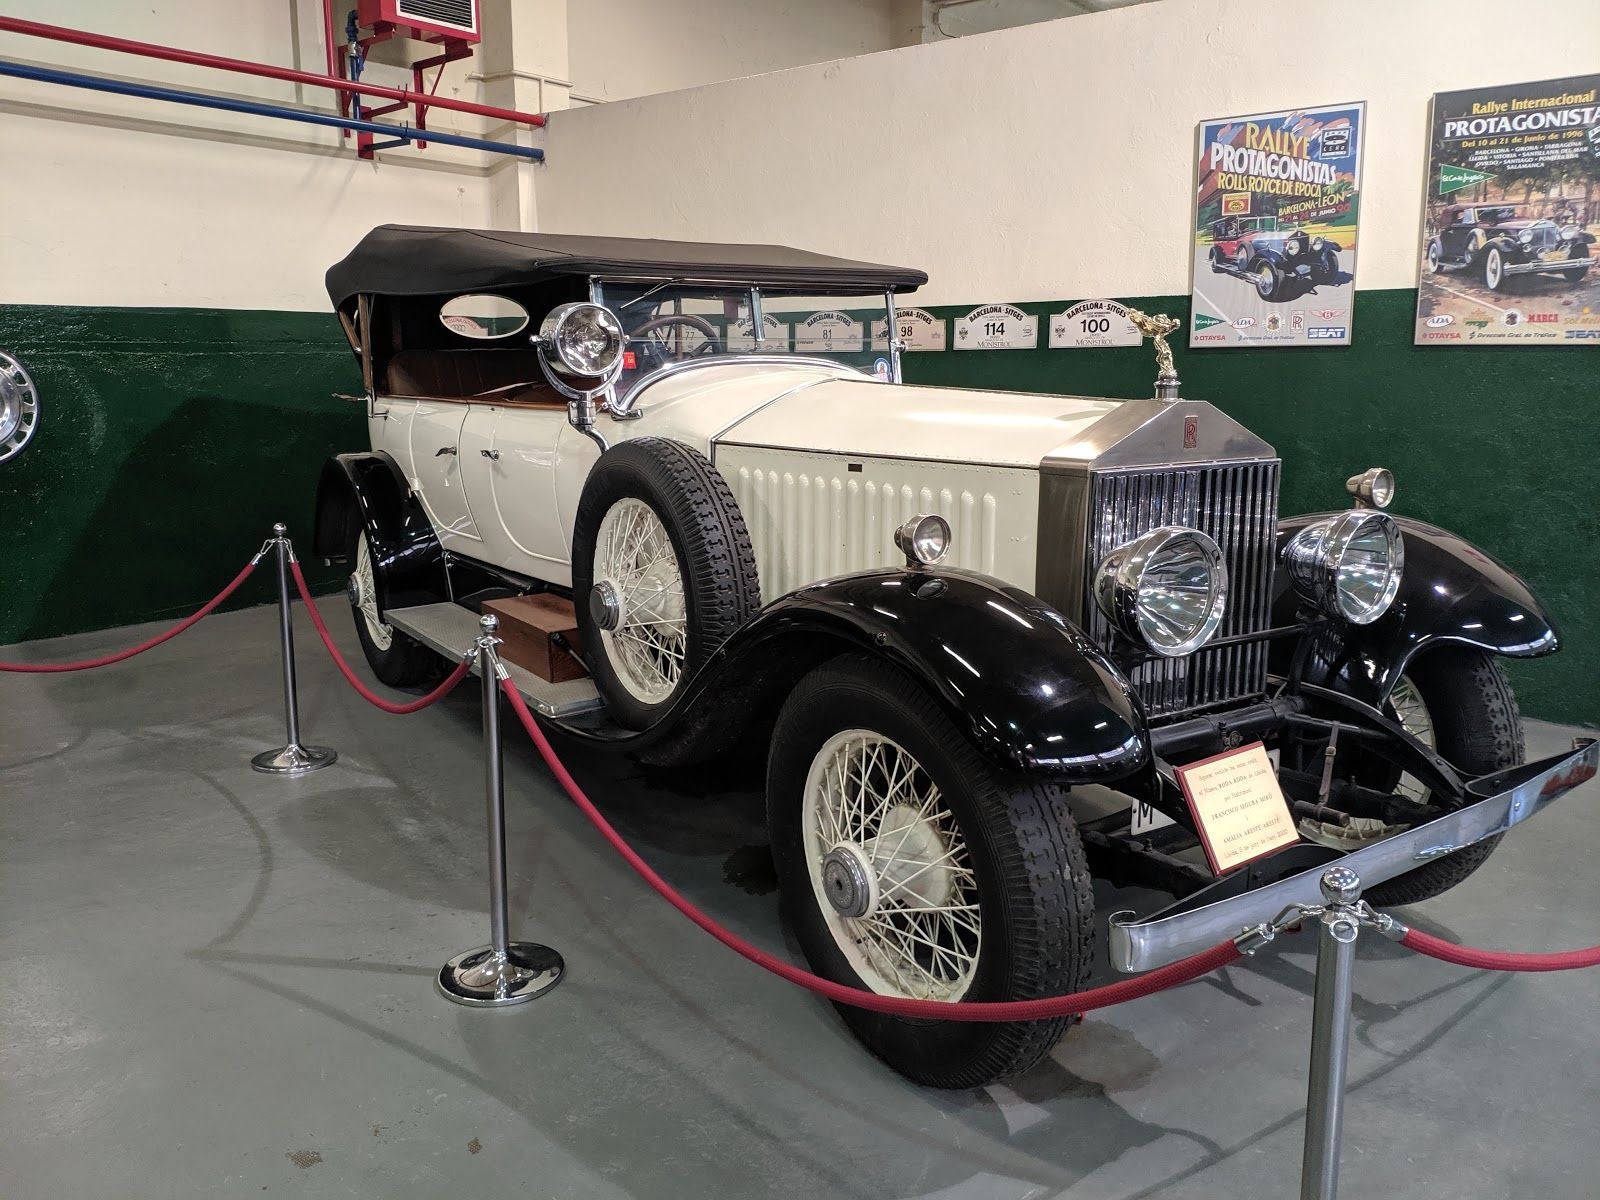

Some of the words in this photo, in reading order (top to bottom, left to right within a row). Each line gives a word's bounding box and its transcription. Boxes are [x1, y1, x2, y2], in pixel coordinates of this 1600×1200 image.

[1471, 101, 1508, 115] Rallye
[1511, 89, 1596, 111] Internacional
[1245, 122, 1311, 159] RALLYE
[1461, 140, 1476, 148] Del
[1478, 138, 1488, 147] 10
[1490, 137, 1497, 146] al
[1499, 136, 1509, 145] 21
[1511, 135, 1522, 144] de
[1548, 132, 1559, 140] de
[1562, 130, 1584, 139] 1996
[1474, 147, 1510, 155] BARCELONA
[1544, 141, 1582, 150] TARRAGONA
[1210, 141, 1337, 184] PROTAGONISTAS
[1506, 162, 1545, 170] SALAMANCA
[1217, 172, 1247, 191] ROLLS
[1250, 176, 1281, 193] ROYCE
[1281, 180, 1292, 196] DE
[1294, 182, 1322, 198] EPOCA
[1318, 208, 1336, 217] JUNIO
[1527, 313, 1559, 322] MARCA
[900, 325, 913, 337] 98
[984, 322, 1005, 336] 114
[1080, 318, 1110, 333] 100
[685, 331, 695, 341] 77
[822, 329, 832, 340] 81
[1308, 328, 1345, 338] SEAT
[1137, 799, 1153, 828] M
